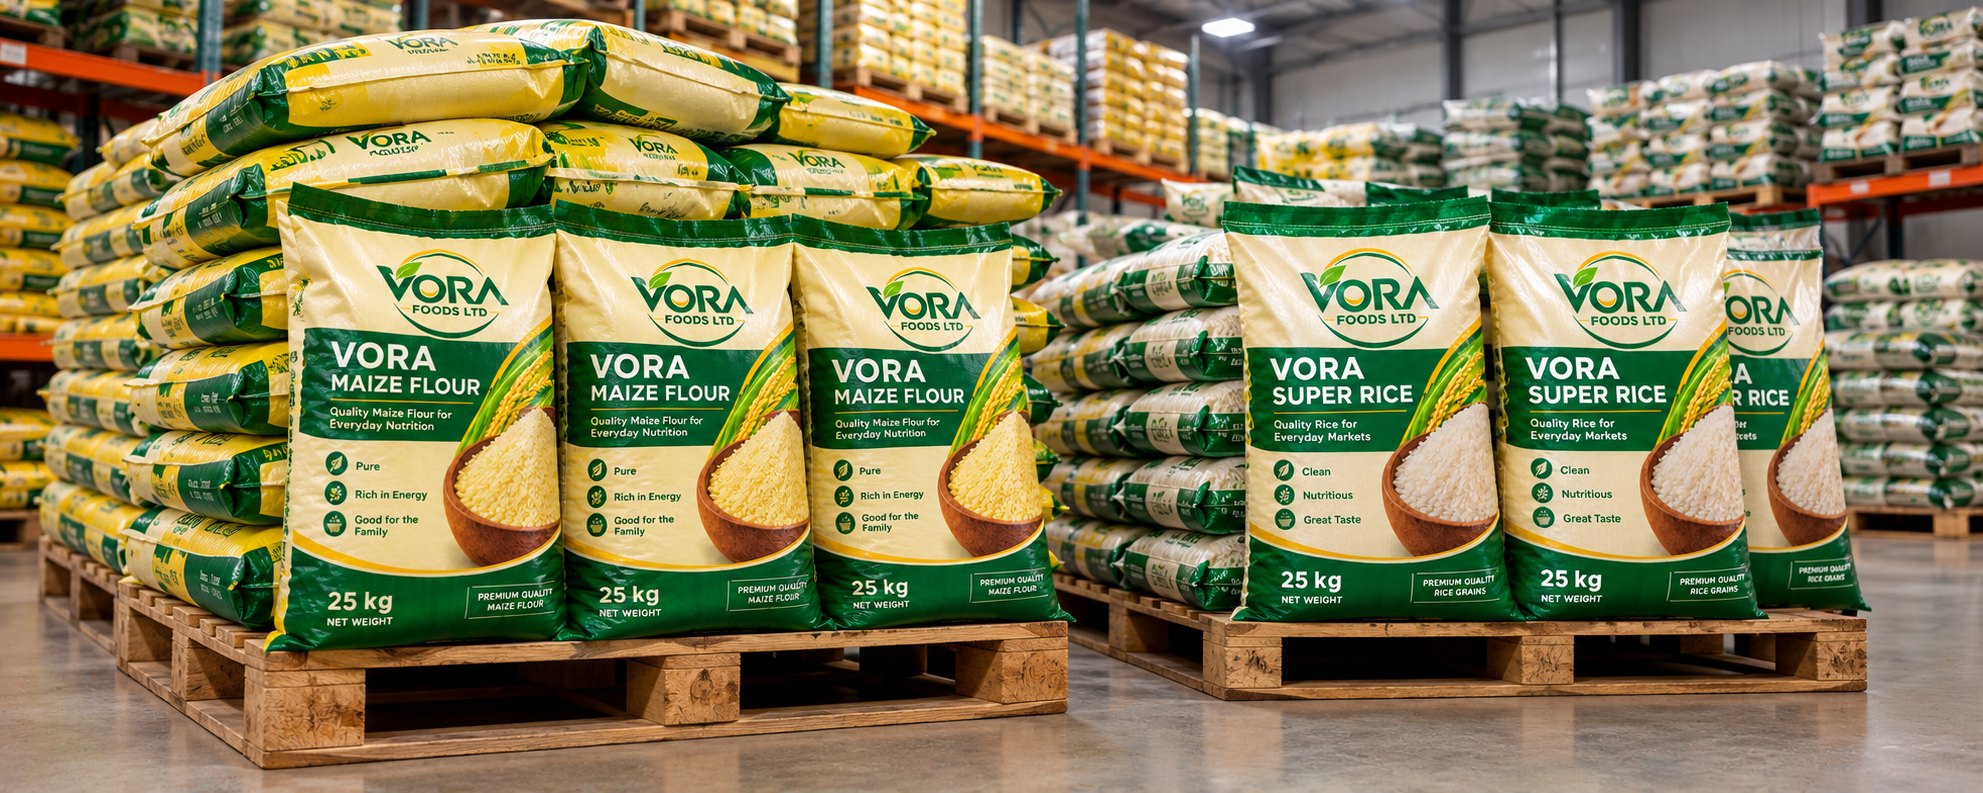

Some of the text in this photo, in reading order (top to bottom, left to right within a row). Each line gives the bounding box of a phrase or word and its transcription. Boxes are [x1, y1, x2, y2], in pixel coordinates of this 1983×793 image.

[385, 37, 459, 50] VORA
[346, 130, 432, 150] VORA
[628, 136, 679, 155] VORA
[376, 264, 509, 306] VORA
[631, 276, 754, 314] VORA
[1300, 272, 1440, 313] VORA
[1553, 273, 1687, 314] VORA
[866, 286, 981, 320] VORA
[412, 304, 488, 317] FOODS LTD
[1725, 295, 1800, 325] ORA
[665, 315, 735, 326] FOODS LTD
[1336, 313, 1416, 325] FOODS LTD
[1591, 316, 1667, 326] FOODS LTD
[901, 322, 964, 331] FOODS LTD
[1728, 326, 1785, 336] FOODS LTD
[331, 341, 436, 372] VORA
[590, 354, 690, 380] VORA
[832, 359, 926, 383] VORA
[1270, 357, 1365, 381] VORA
[1525, 356, 1620, 380] VORA
[331, 374, 480, 396] MAIZE FLOUR
[591, 385, 730, 402] MAIZE FLOUR
[835, 388, 964, 405] MAIZE FLOUR
[1272, 385, 1413, 406] SUPER RICE
[1529, 385, 1667, 404] SUPER RICE
[1748, 389, 1790, 407] RICE
[330, 406, 453, 420] Quality Maize Flour for
[330, 419, 383, 432] Everyday
[591, 415, 703, 427] Quality Maize Flour for
[835, 417, 941, 430] Quality Maize Flour for
[1274, 419, 1358, 431] Quality Rice for
[1530, 418, 1615, 429] Quality Rice for
[591, 427, 688, 439] Everyday Nutrition
[835, 429, 926, 441] Everyday Nutrition
[1274, 431, 1371, 444] Everyday Markets
[1530, 431, 1628, 442] Everyday Markets
[356, 462, 380, 472] Pure
[614, 467, 637, 476] Pure
[859, 467, 881, 475] Pure
[1301, 467, 1331, 477] Clean
[1560, 465, 1590, 475] Clean
[355, 490, 428, 501] Rich in Energy
[614, 492, 682, 503] Rich in Energy
[860, 490, 924, 501] Rich in Energy
[1303, 490, 1353, 500] Nutritious
[1561, 489, 1613, 499] Nutritious
[354, 515, 419, 525] Good for the
[614, 514, 675, 525] Good for the
[861, 511, 919, 522] Good for the
[1303, 515, 1361, 525] Great Taste
[1563, 514, 1621, 524] Great Taste
[354, 527, 389, 538] Family
[614, 526, 645, 537] Family
[862, 523, 892, 533] Family
[980, 577, 1015, 587] PREMIUM
[1281, 570, 1342, 592] 25 kg
[1423, 578, 1462, 587] PREMIUM
[1541, 569, 1602, 592] 25 kg
[1680, 576, 1716, 586] PREMIUM
[1807, 575, 1823, 583] RICE
[738, 584, 776, 594] PREMIUM
[851, 579, 909, 599] 25 kg
[988, 587, 1011, 596] MAIZE
[1434, 587, 1486, 597] RICE GRAINS
[1690, 585, 1738, 595] RICE GRAINS
[478, 591, 519, 602] PREMIUM
[599, 585, 659, 606] 25 kg
[748, 593, 800, 604] MAIZE FLOUR
[1281, 596, 1343, 604] NET WEIGHT
[1541, 594, 1603, 603] NET WEIGHT
[327, 591, 393, 614] 25 kg
[487, 600, 544, 611] MAIZE FLOUR
[853, 600, 909, 609] NET WEIGHT
[599, 608, 662, 617] NET WEIGHT
[327, 616, 393, 627] NET WEIGHT
